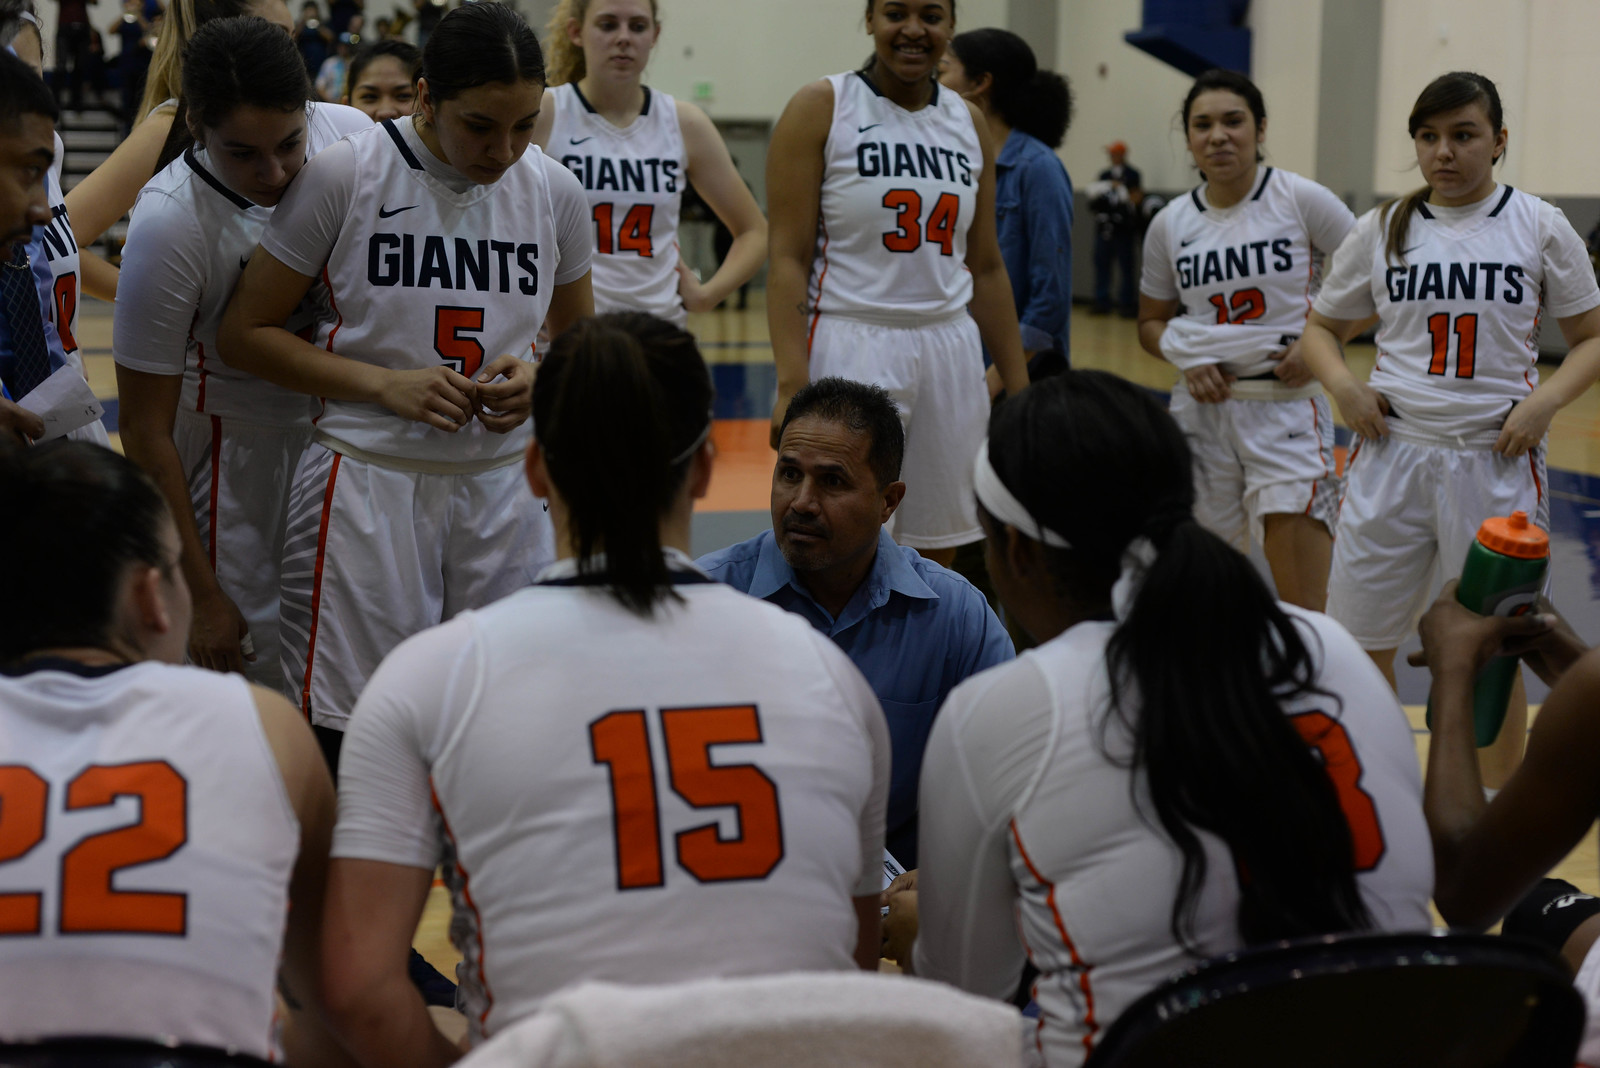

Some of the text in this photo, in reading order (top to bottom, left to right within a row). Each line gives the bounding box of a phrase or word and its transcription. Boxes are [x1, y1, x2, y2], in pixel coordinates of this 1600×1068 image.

[857, 142, 971, 186] GIANTS
[593, 202, 654, 258] 14
[883, 189, 960, 256] 34
[367, 233, 539, 296] GIANTS
[1177, 238, 1292, 289] GIANTS
[1386, 262, 1524, 304] GIANTS
[433, 305, 485, 379] 5
[1427, 311, 1478, 378] 11
[590, 705, 784, 890] 15
